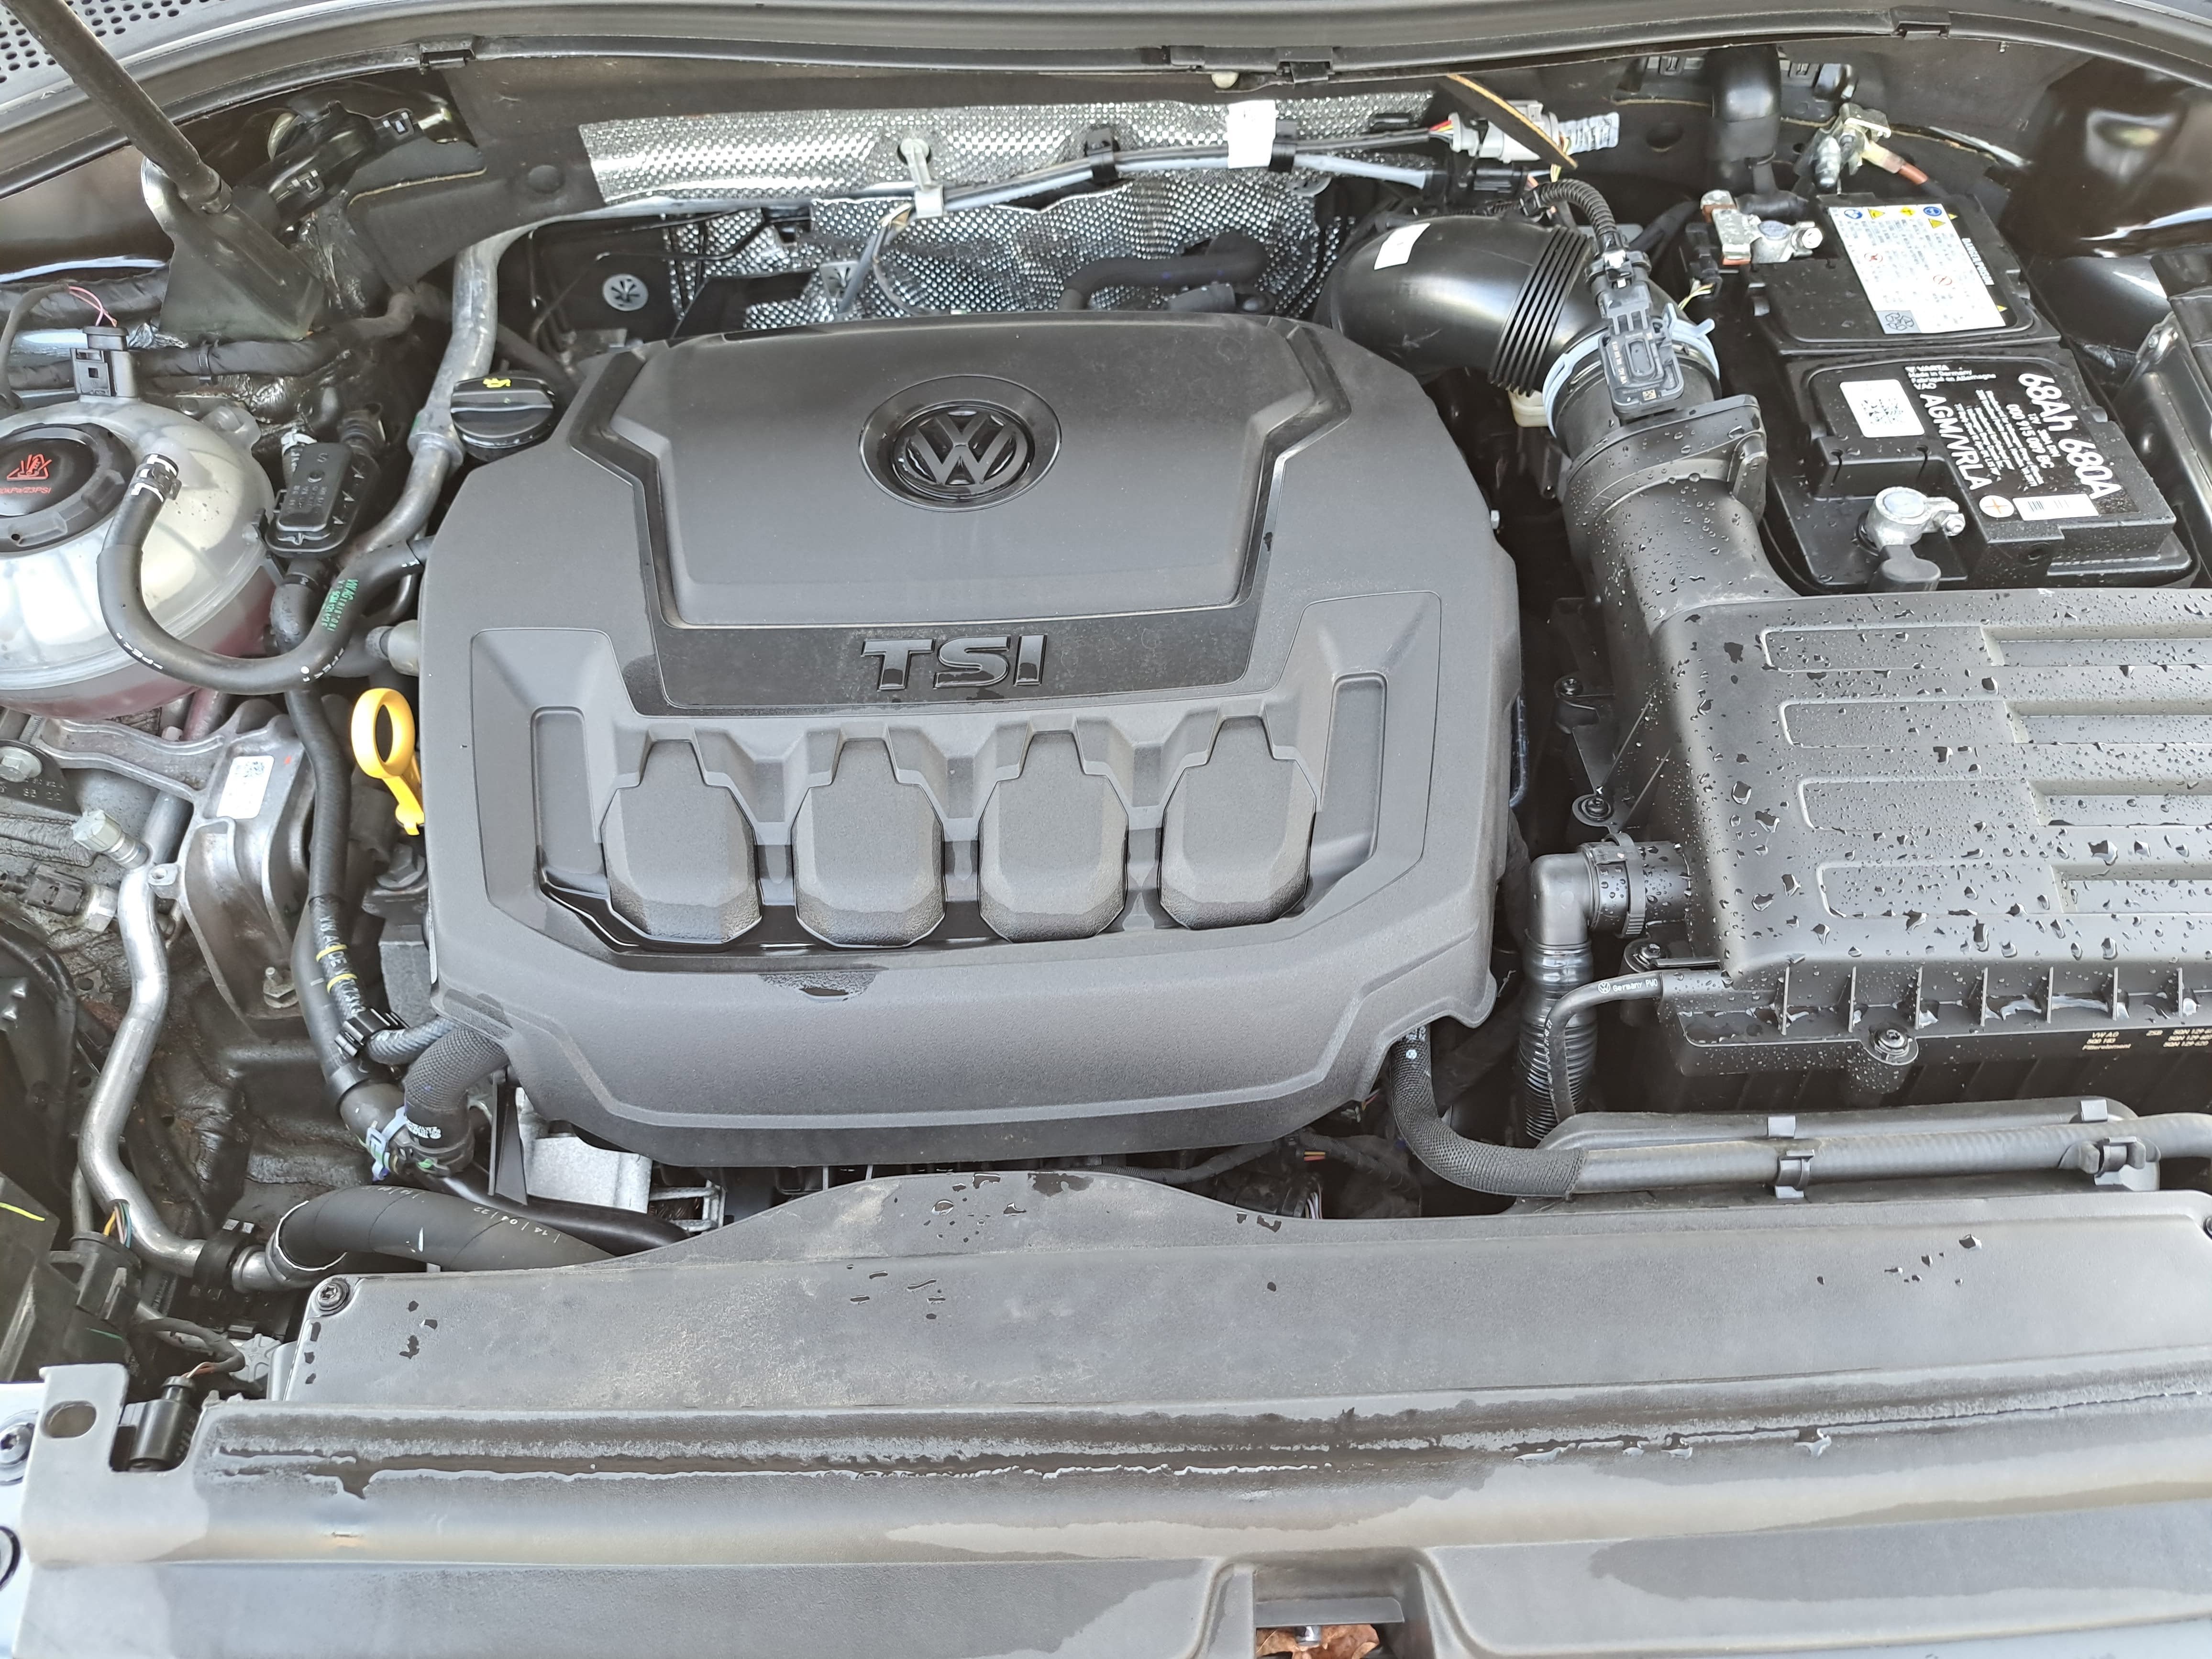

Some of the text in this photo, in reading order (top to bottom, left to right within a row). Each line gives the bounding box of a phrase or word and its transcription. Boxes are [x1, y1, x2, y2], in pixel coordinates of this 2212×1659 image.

[1920, 394, 1992, 490] AGM/VRLA
[2006, 404, 2025, 420] 000
[2016, 420, 2036, 436] 915
[2036, 455, 2055, 468] BC
[2018, 373, 2122, 499] 68Ah 680A
[861, 633, 1049, 692] TSI
[1613, 982, 1643, 992] Germany
